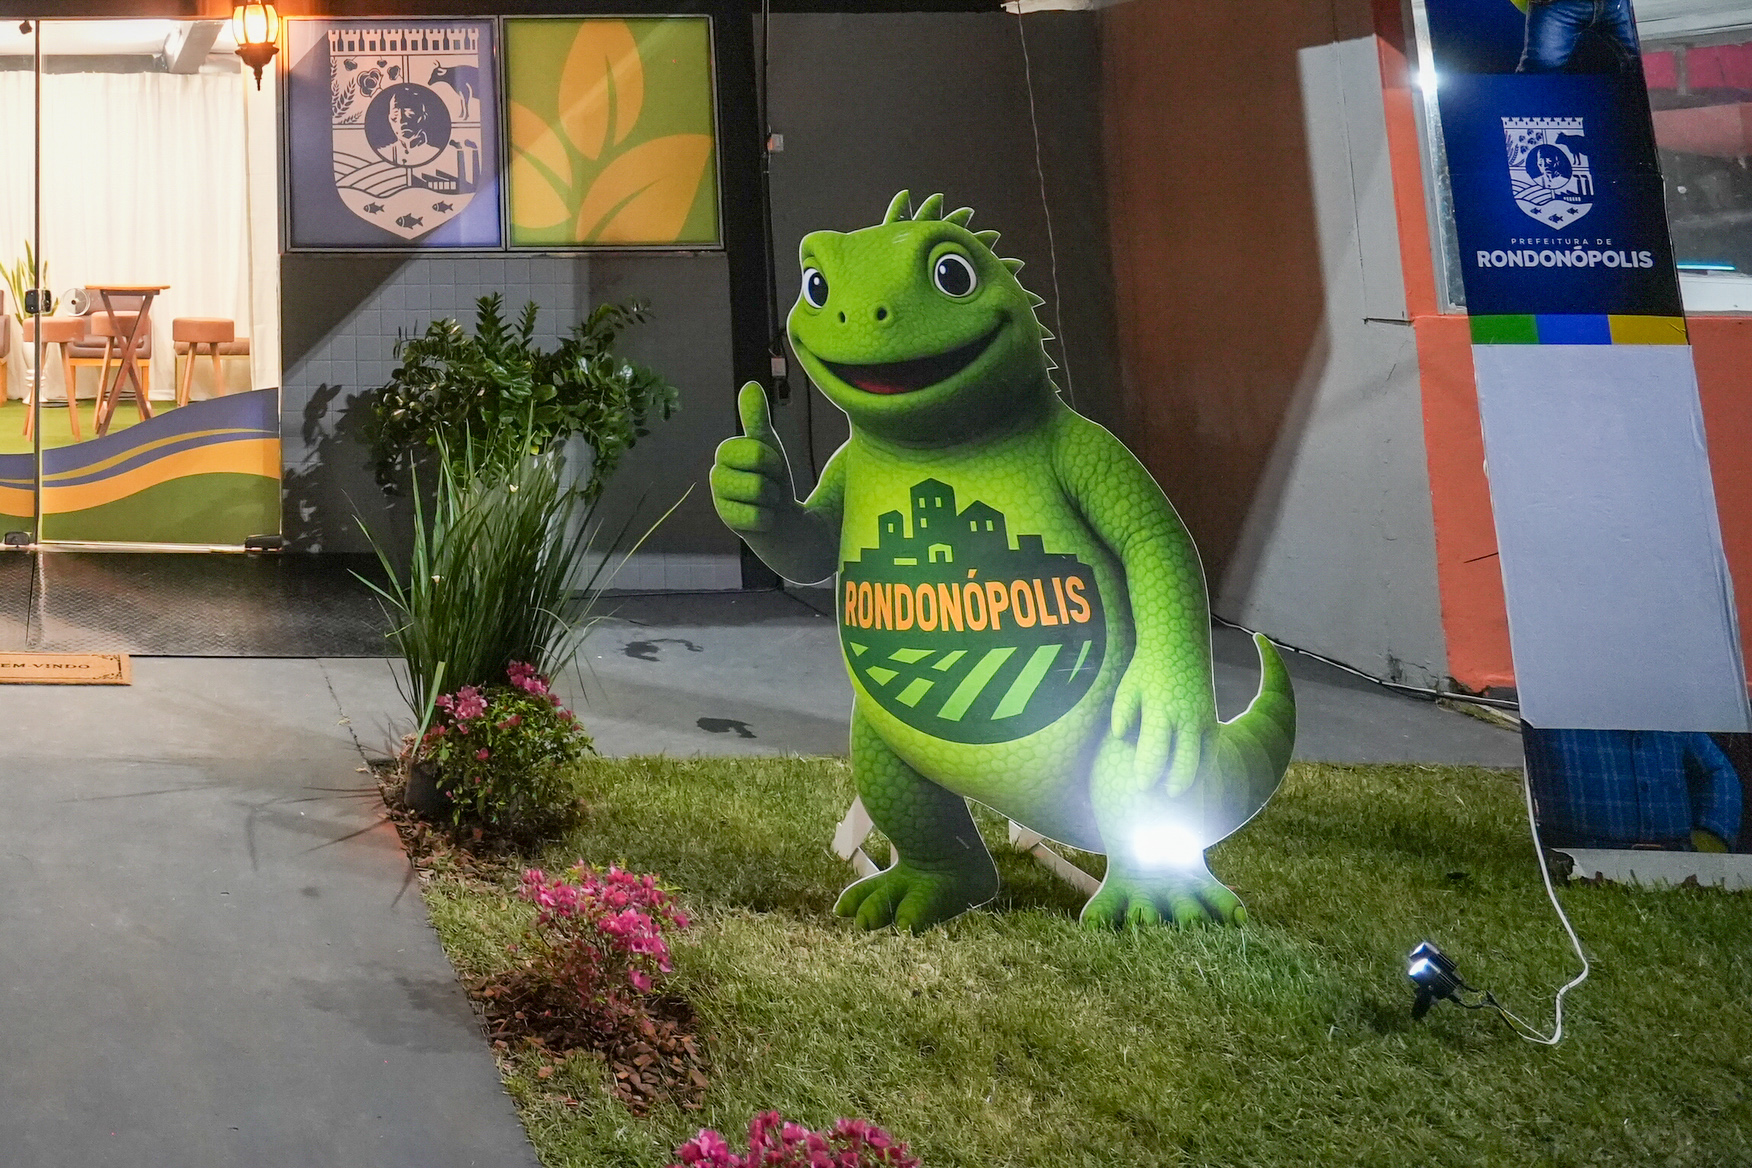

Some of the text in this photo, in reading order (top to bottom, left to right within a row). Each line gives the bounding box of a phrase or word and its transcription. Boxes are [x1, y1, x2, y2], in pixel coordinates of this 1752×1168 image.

[1510, 237, 1589, 245] PREFEITURA
[1476, 245, 1653, 268] RONDONÓPOLIS
[844, 568, 1092, 632] RONDONÓPOLIS
